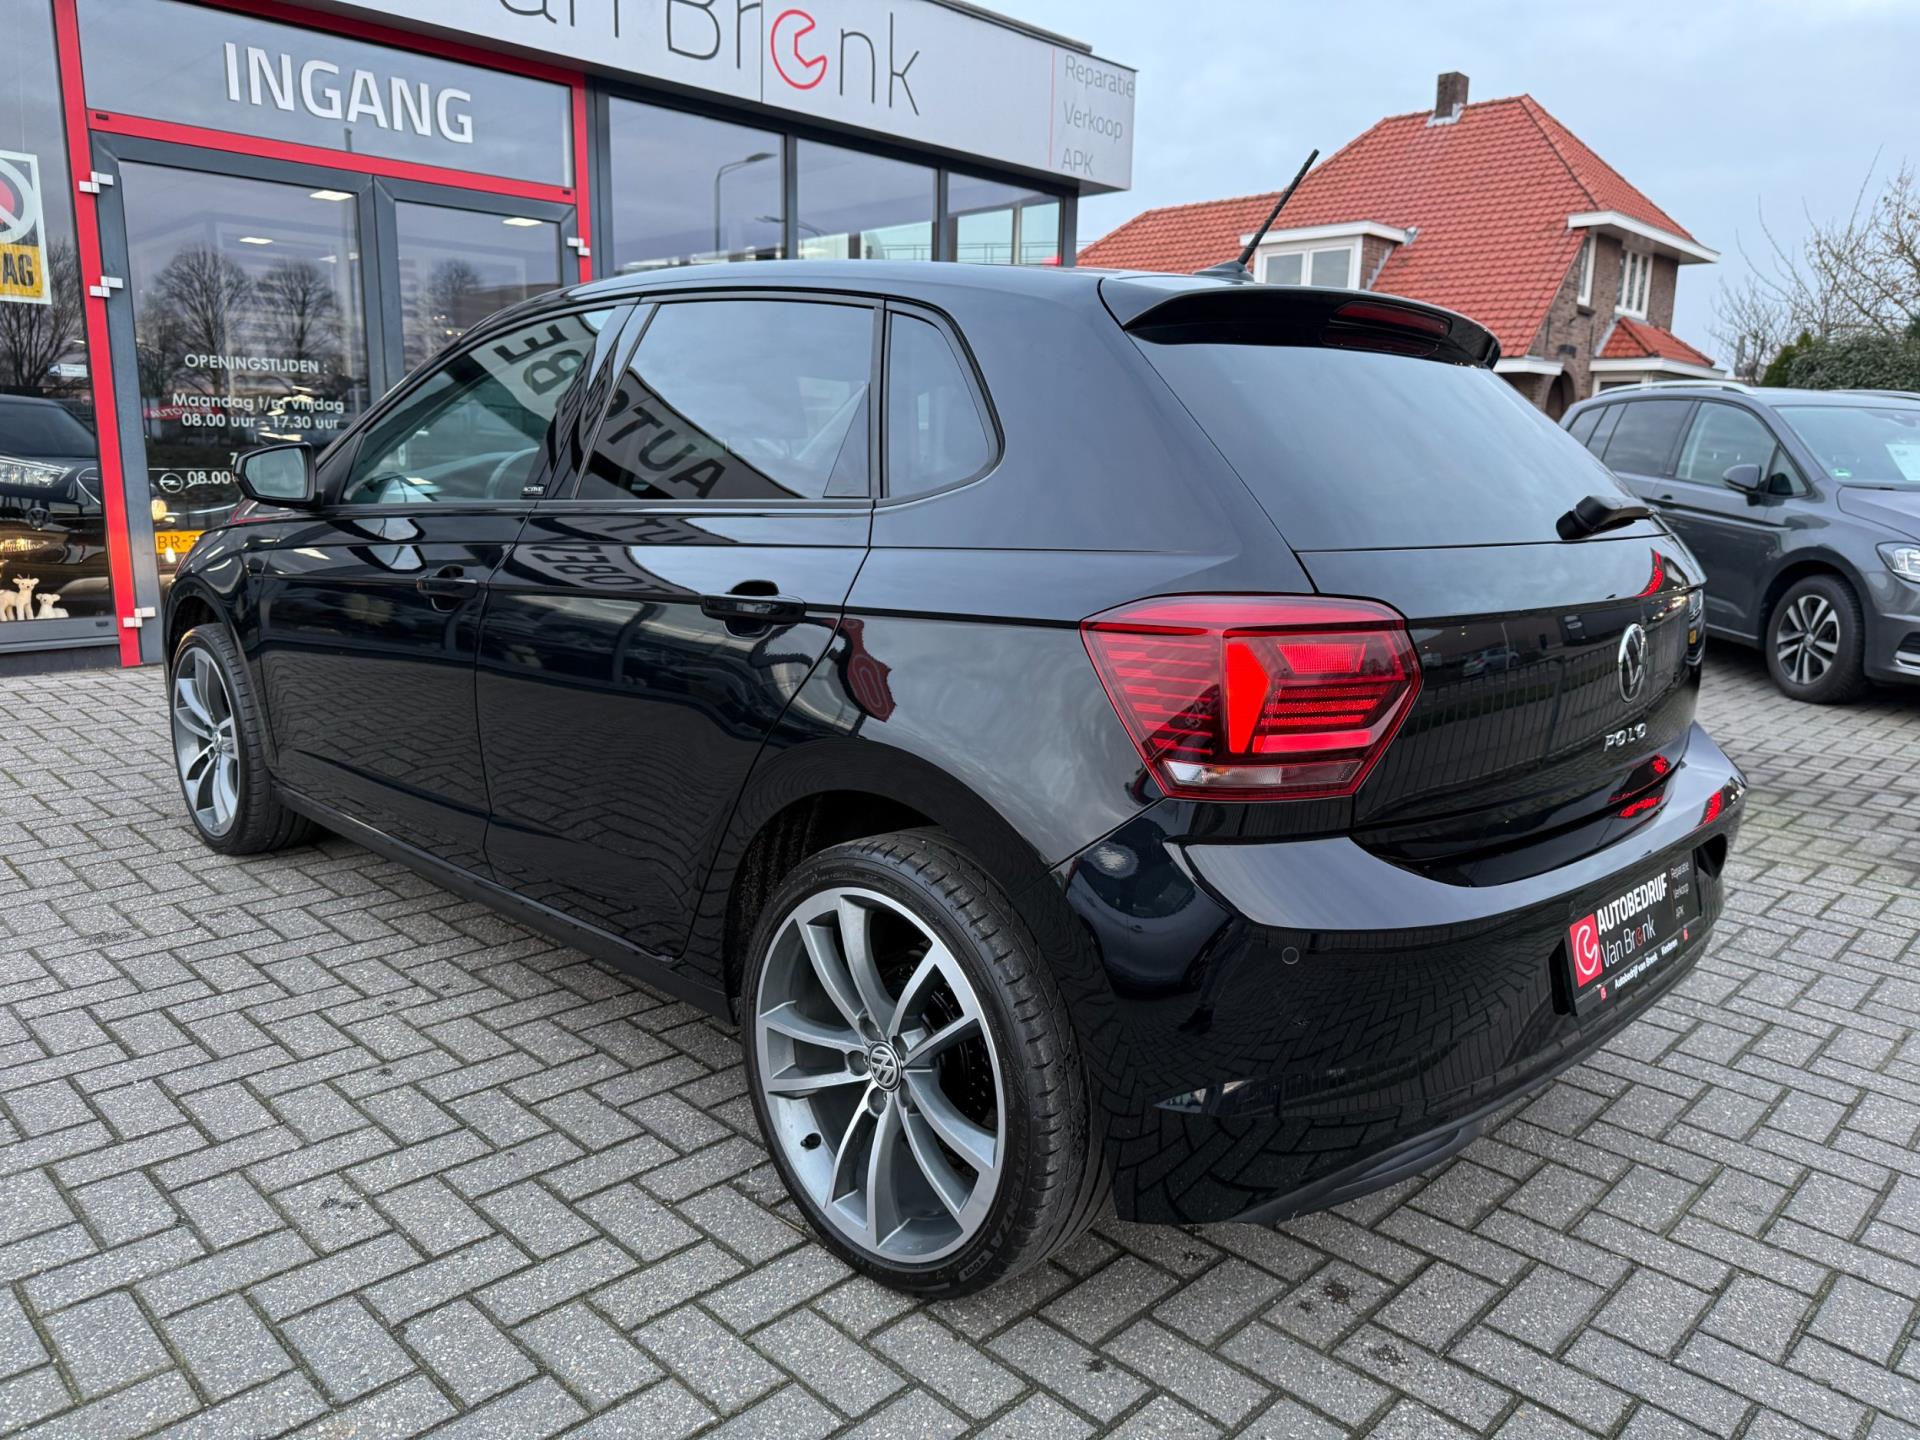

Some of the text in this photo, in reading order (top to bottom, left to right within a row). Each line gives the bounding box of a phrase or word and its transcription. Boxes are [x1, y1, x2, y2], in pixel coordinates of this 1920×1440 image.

[1064, 54, 1135, 98] Reparatie
[223, 42, 474, 145] INGANG
[1063, 100, 1124, 144] Verkoop
[1061, 147, 1095, 176] APK
[184, 353, 319, 373] OPENINGSTIJDEN
[172, 393, 254, 411] Maandag
[181, 412, 226, 428] 08.00
[231, 418, 255, 427] uur
[272, 415, 312, 429] 17.30
[315, 418, 340, 428] uur
[187, 471, 231, 485] 08.00
[1603, 722, 1647, 753] POLO
[1597, 873, 1667, 935] AUTOBEDRIJF
[1601, 940, 1624, 968] Van
